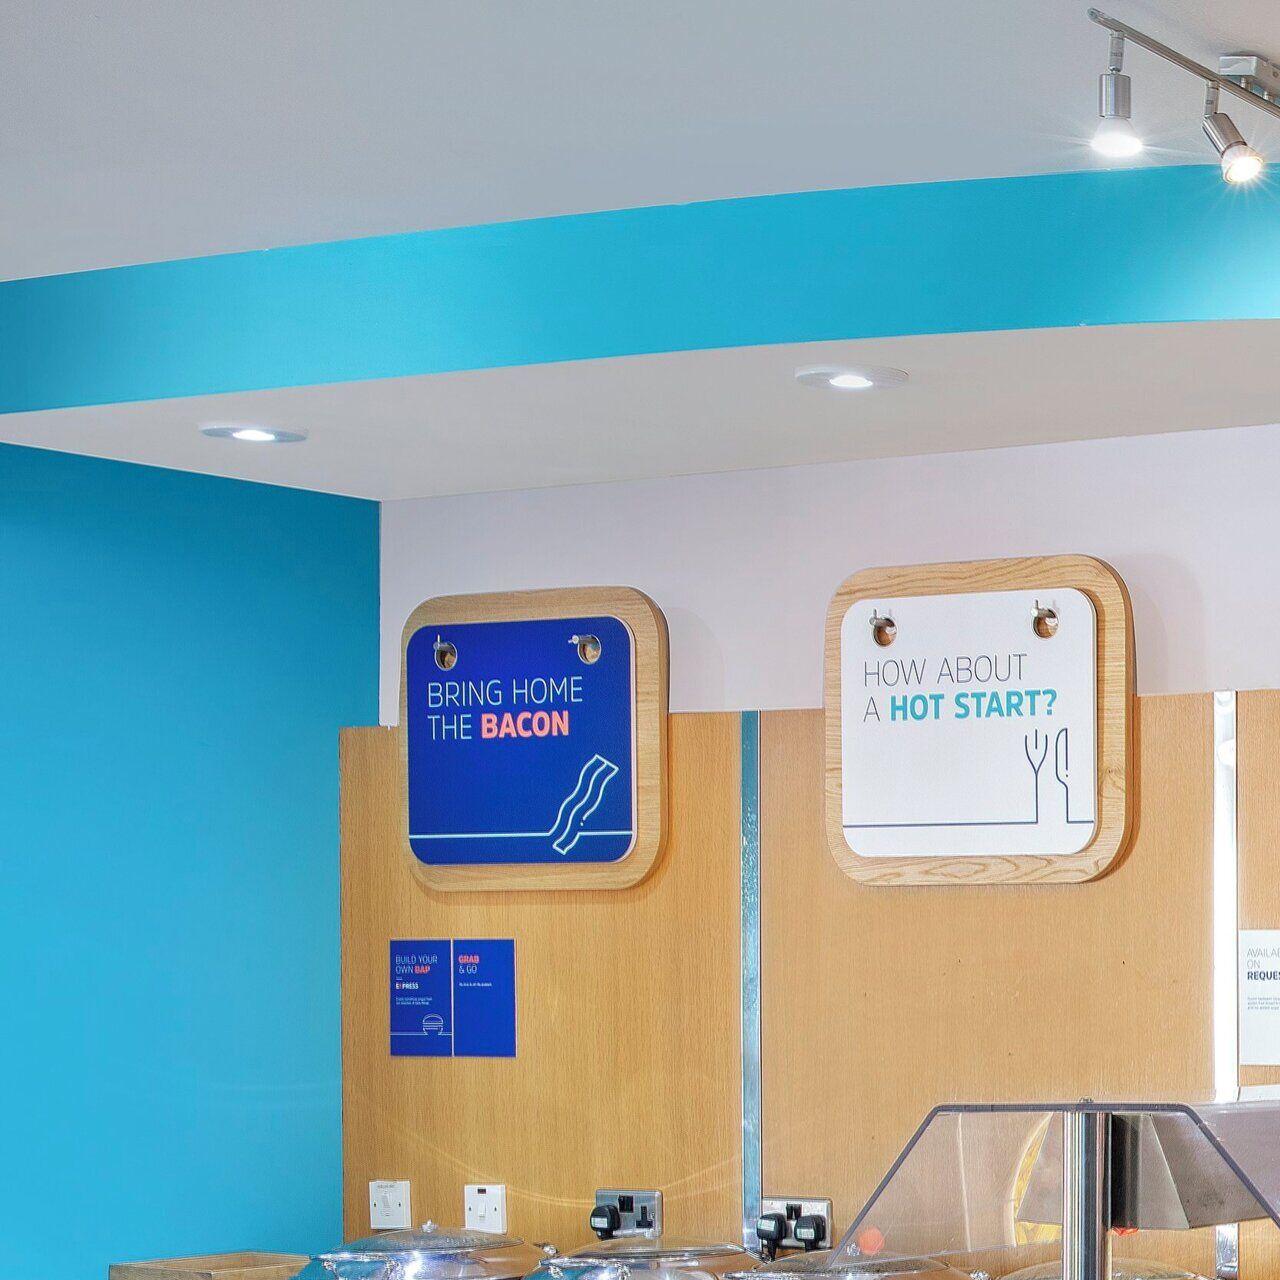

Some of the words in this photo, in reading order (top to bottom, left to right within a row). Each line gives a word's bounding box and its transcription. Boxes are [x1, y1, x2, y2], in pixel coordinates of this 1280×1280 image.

[864, 658, 927, 687] HOW
[937, 653, 1028, 684] ABOUT
[428, 680, 502, 708] BRING
[513, 676, 583, 704] HOME
[863, 696, 881, 722] A
[890, 694, 945, 721] HOT
[954, 689, 1057, 719] START?
[427, 714, 472, 740] THE
[481, 710, 570, 739] BACON
[396, 954, 416, 964] BUILD
[419, 954, 438, 964] YOUR
[466, 964, 477, 974] GO
[1247, 959, 1261, 969] ON
[396, 965, 414, 974] OWN
